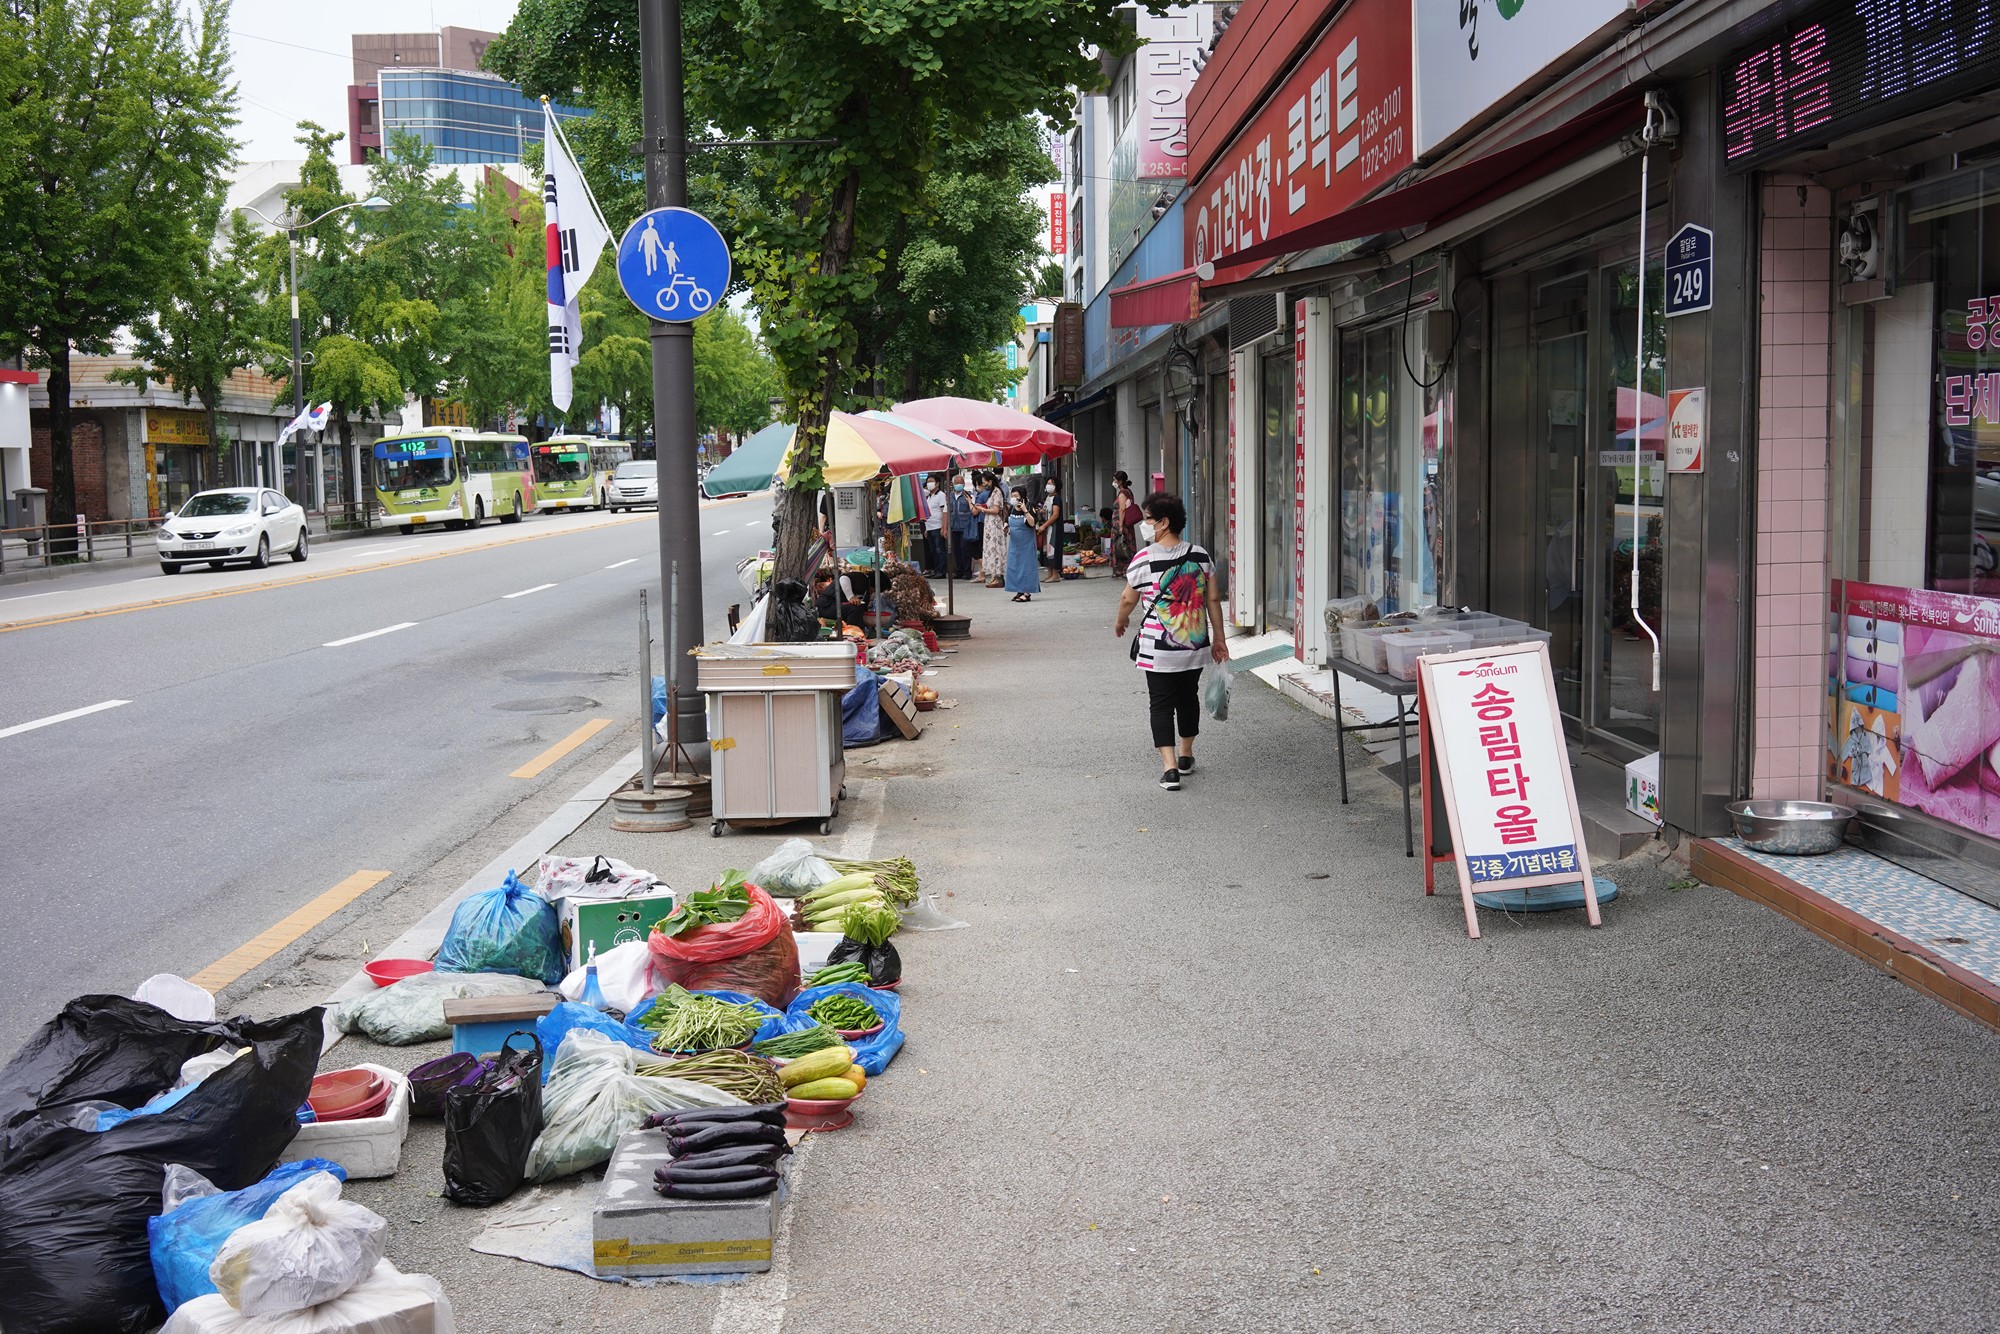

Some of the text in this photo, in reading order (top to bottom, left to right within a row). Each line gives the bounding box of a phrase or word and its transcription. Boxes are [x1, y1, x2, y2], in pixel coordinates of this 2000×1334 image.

[1361, 86, 1402, 144] T.253-0101
[1361, 126, 1403, 182] T.272-5770
[1054, 201, 1063, 243] 화진화장품
[1680, 236, 1697, 253] 팔달로
[1673, 268, 1703, 305] 249
[1945, 372, 2000, 426] 단체
[400, 441, 426, 452] 102
[1671, 421, 1699, 439] kt 텔레캅
[1921, 607, 1950, 626] 전북인의
[1471, 682, 1538, 845] 송림타올
[1471, 849, 1574, 877] 각종 기념타올
